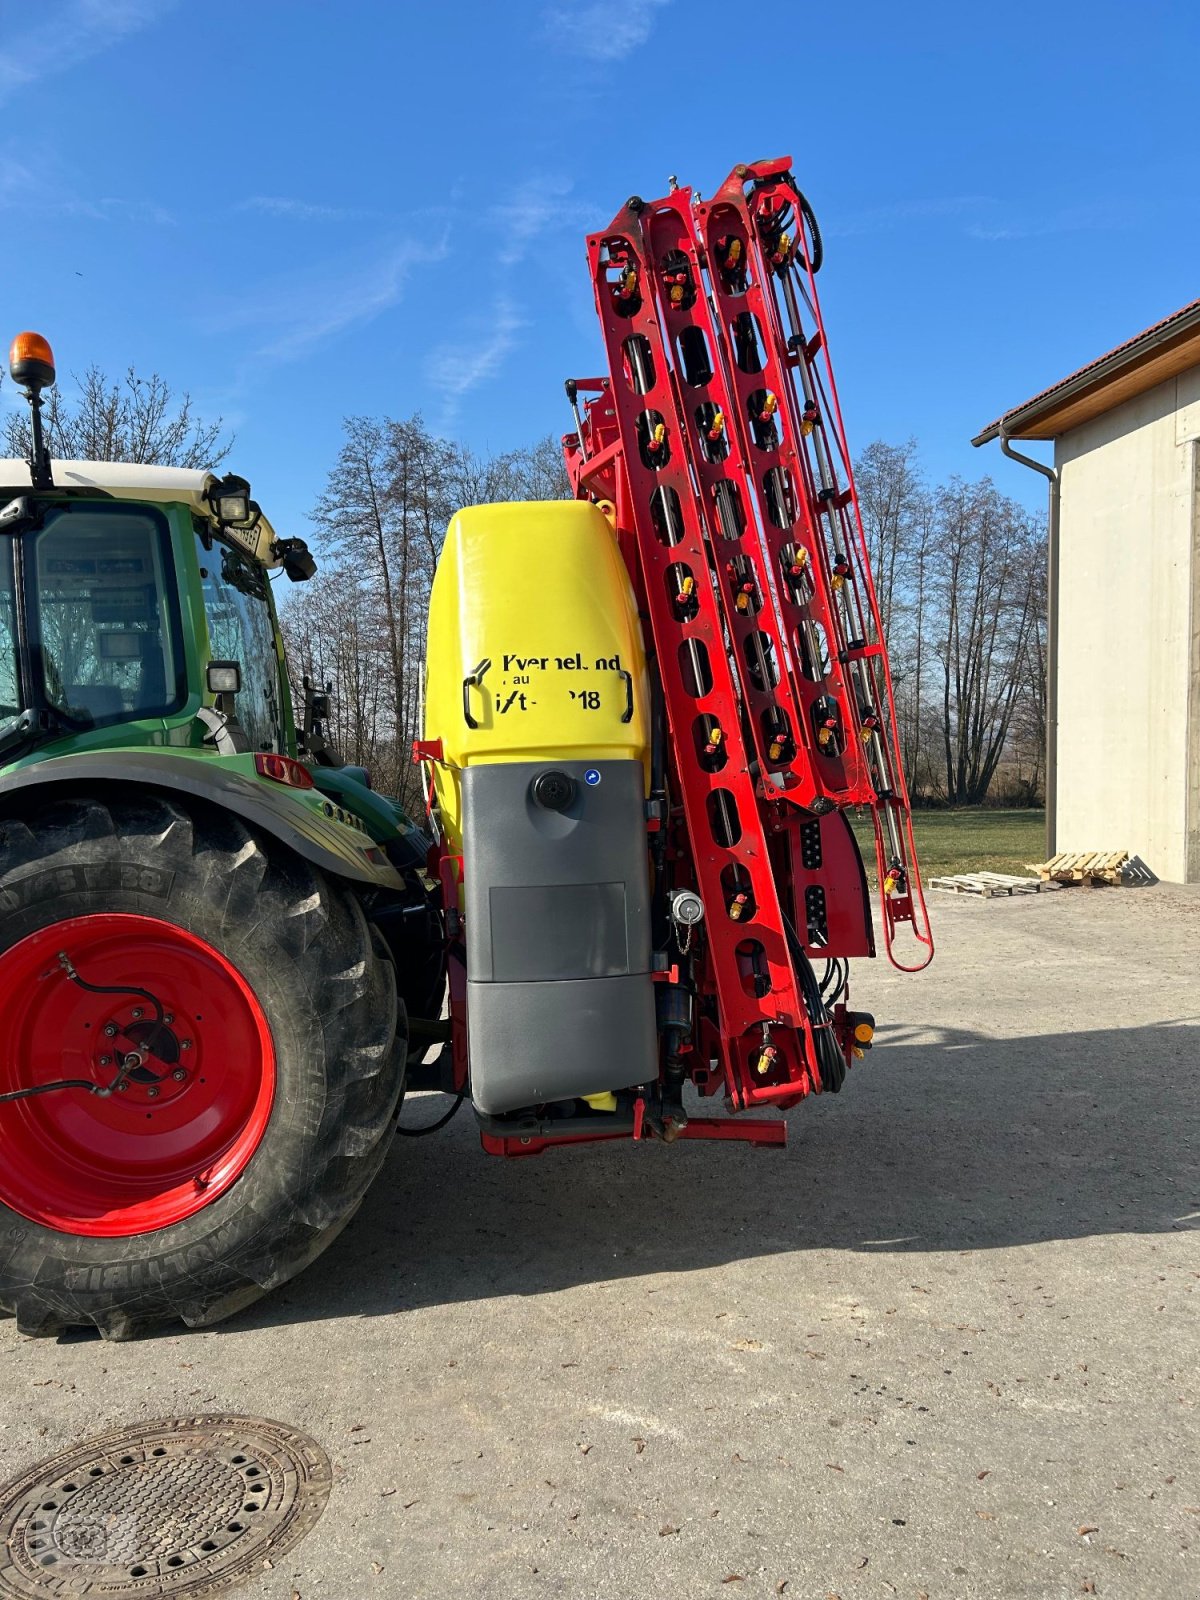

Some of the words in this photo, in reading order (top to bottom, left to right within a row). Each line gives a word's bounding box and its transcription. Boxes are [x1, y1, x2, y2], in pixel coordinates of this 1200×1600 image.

[503, 653, 620, 671] Kvernelnd
[503, 676, 529, 684] au
[121, 866, 161, 892] 38
